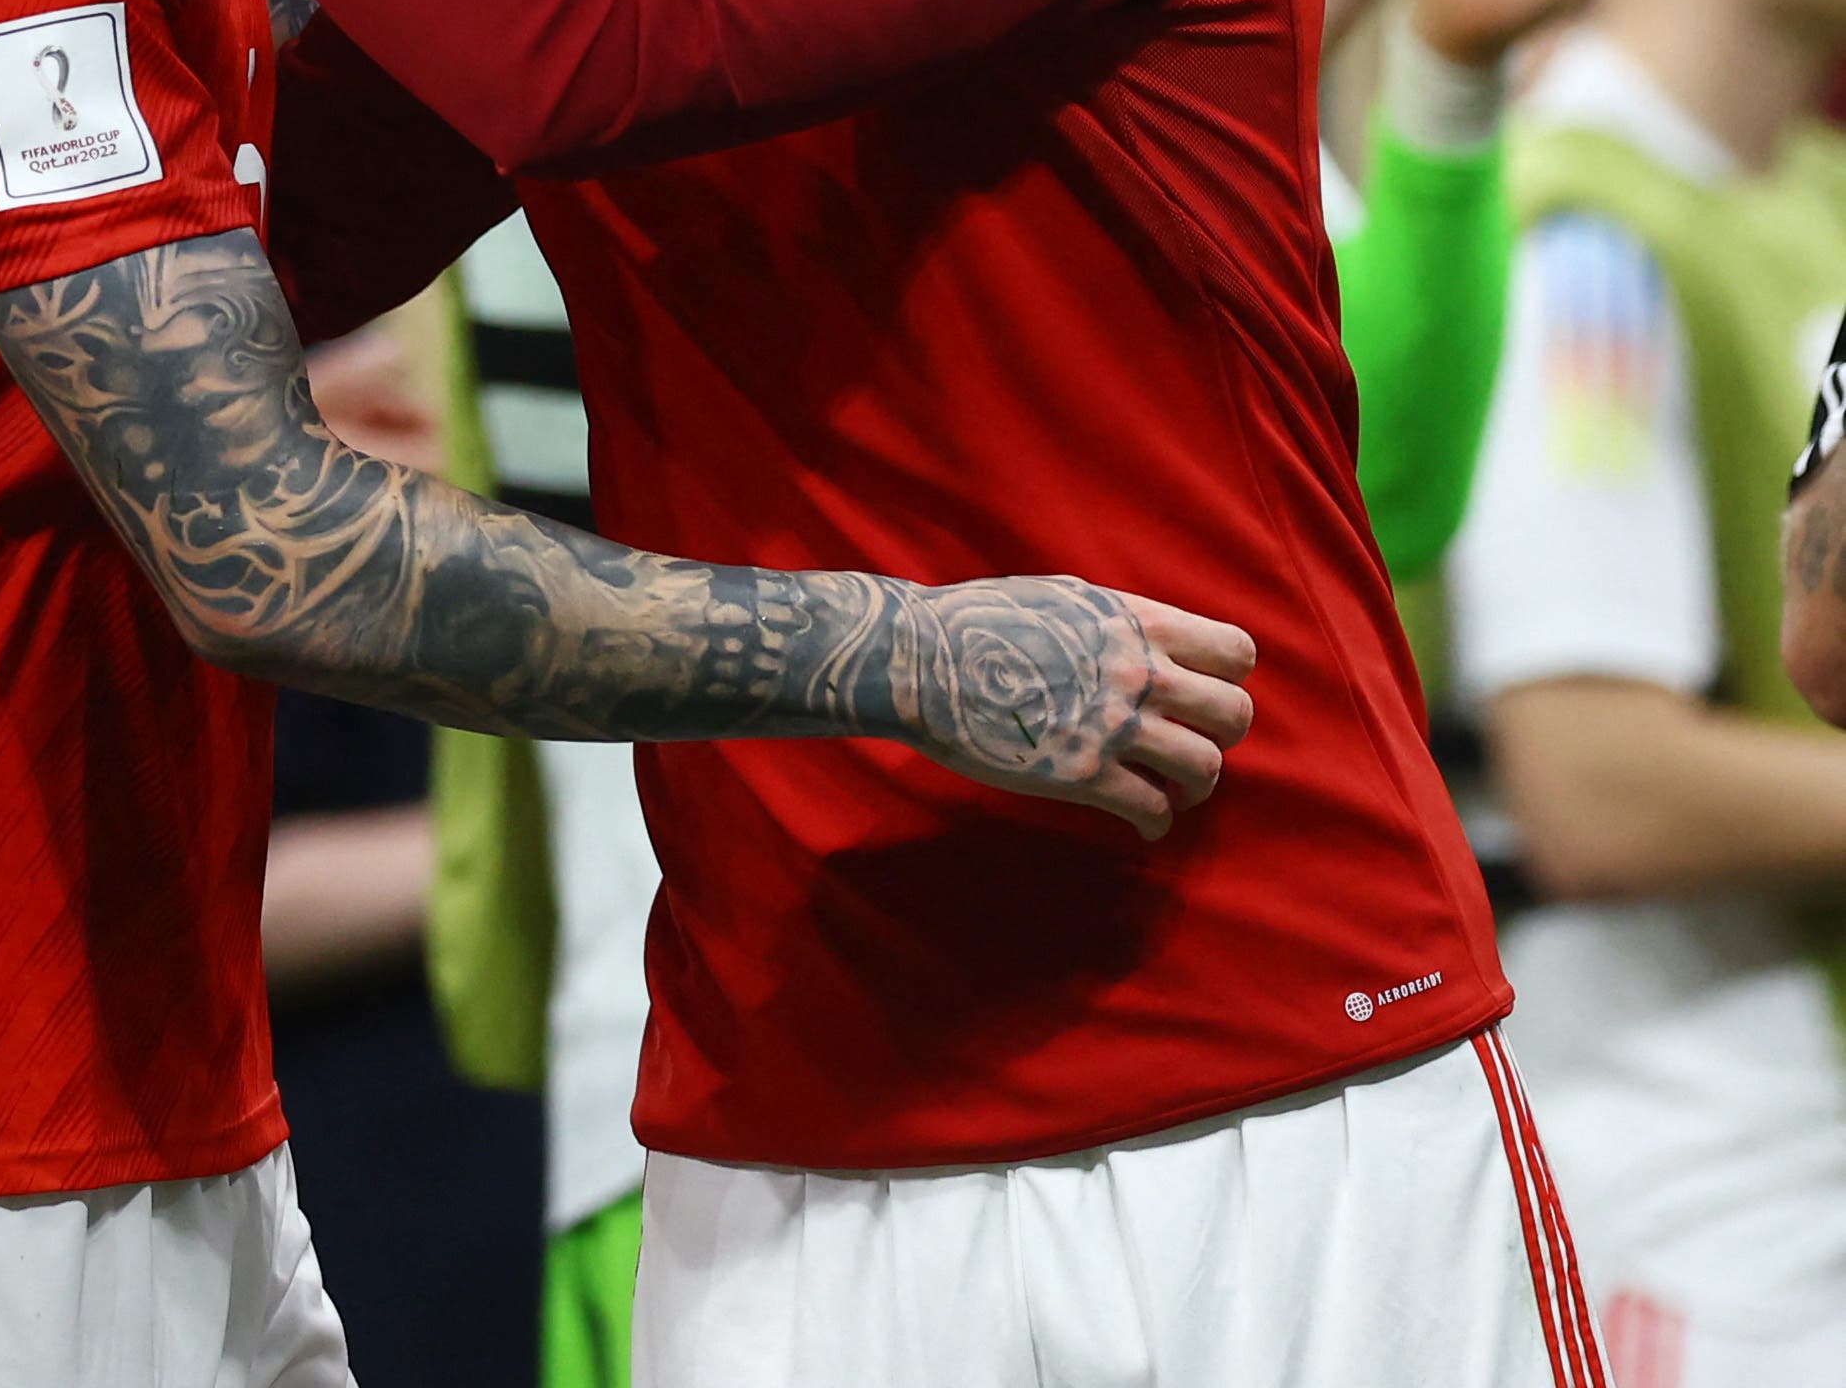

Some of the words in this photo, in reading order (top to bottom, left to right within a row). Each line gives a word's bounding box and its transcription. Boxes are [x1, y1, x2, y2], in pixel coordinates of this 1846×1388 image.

[21, 146, 49, 161] FIFA
[49, 136, 95, 154] WORLD
[97, 129, 121, 143] CUP
[1377, 971, 1443, 1006] AEROREADY
